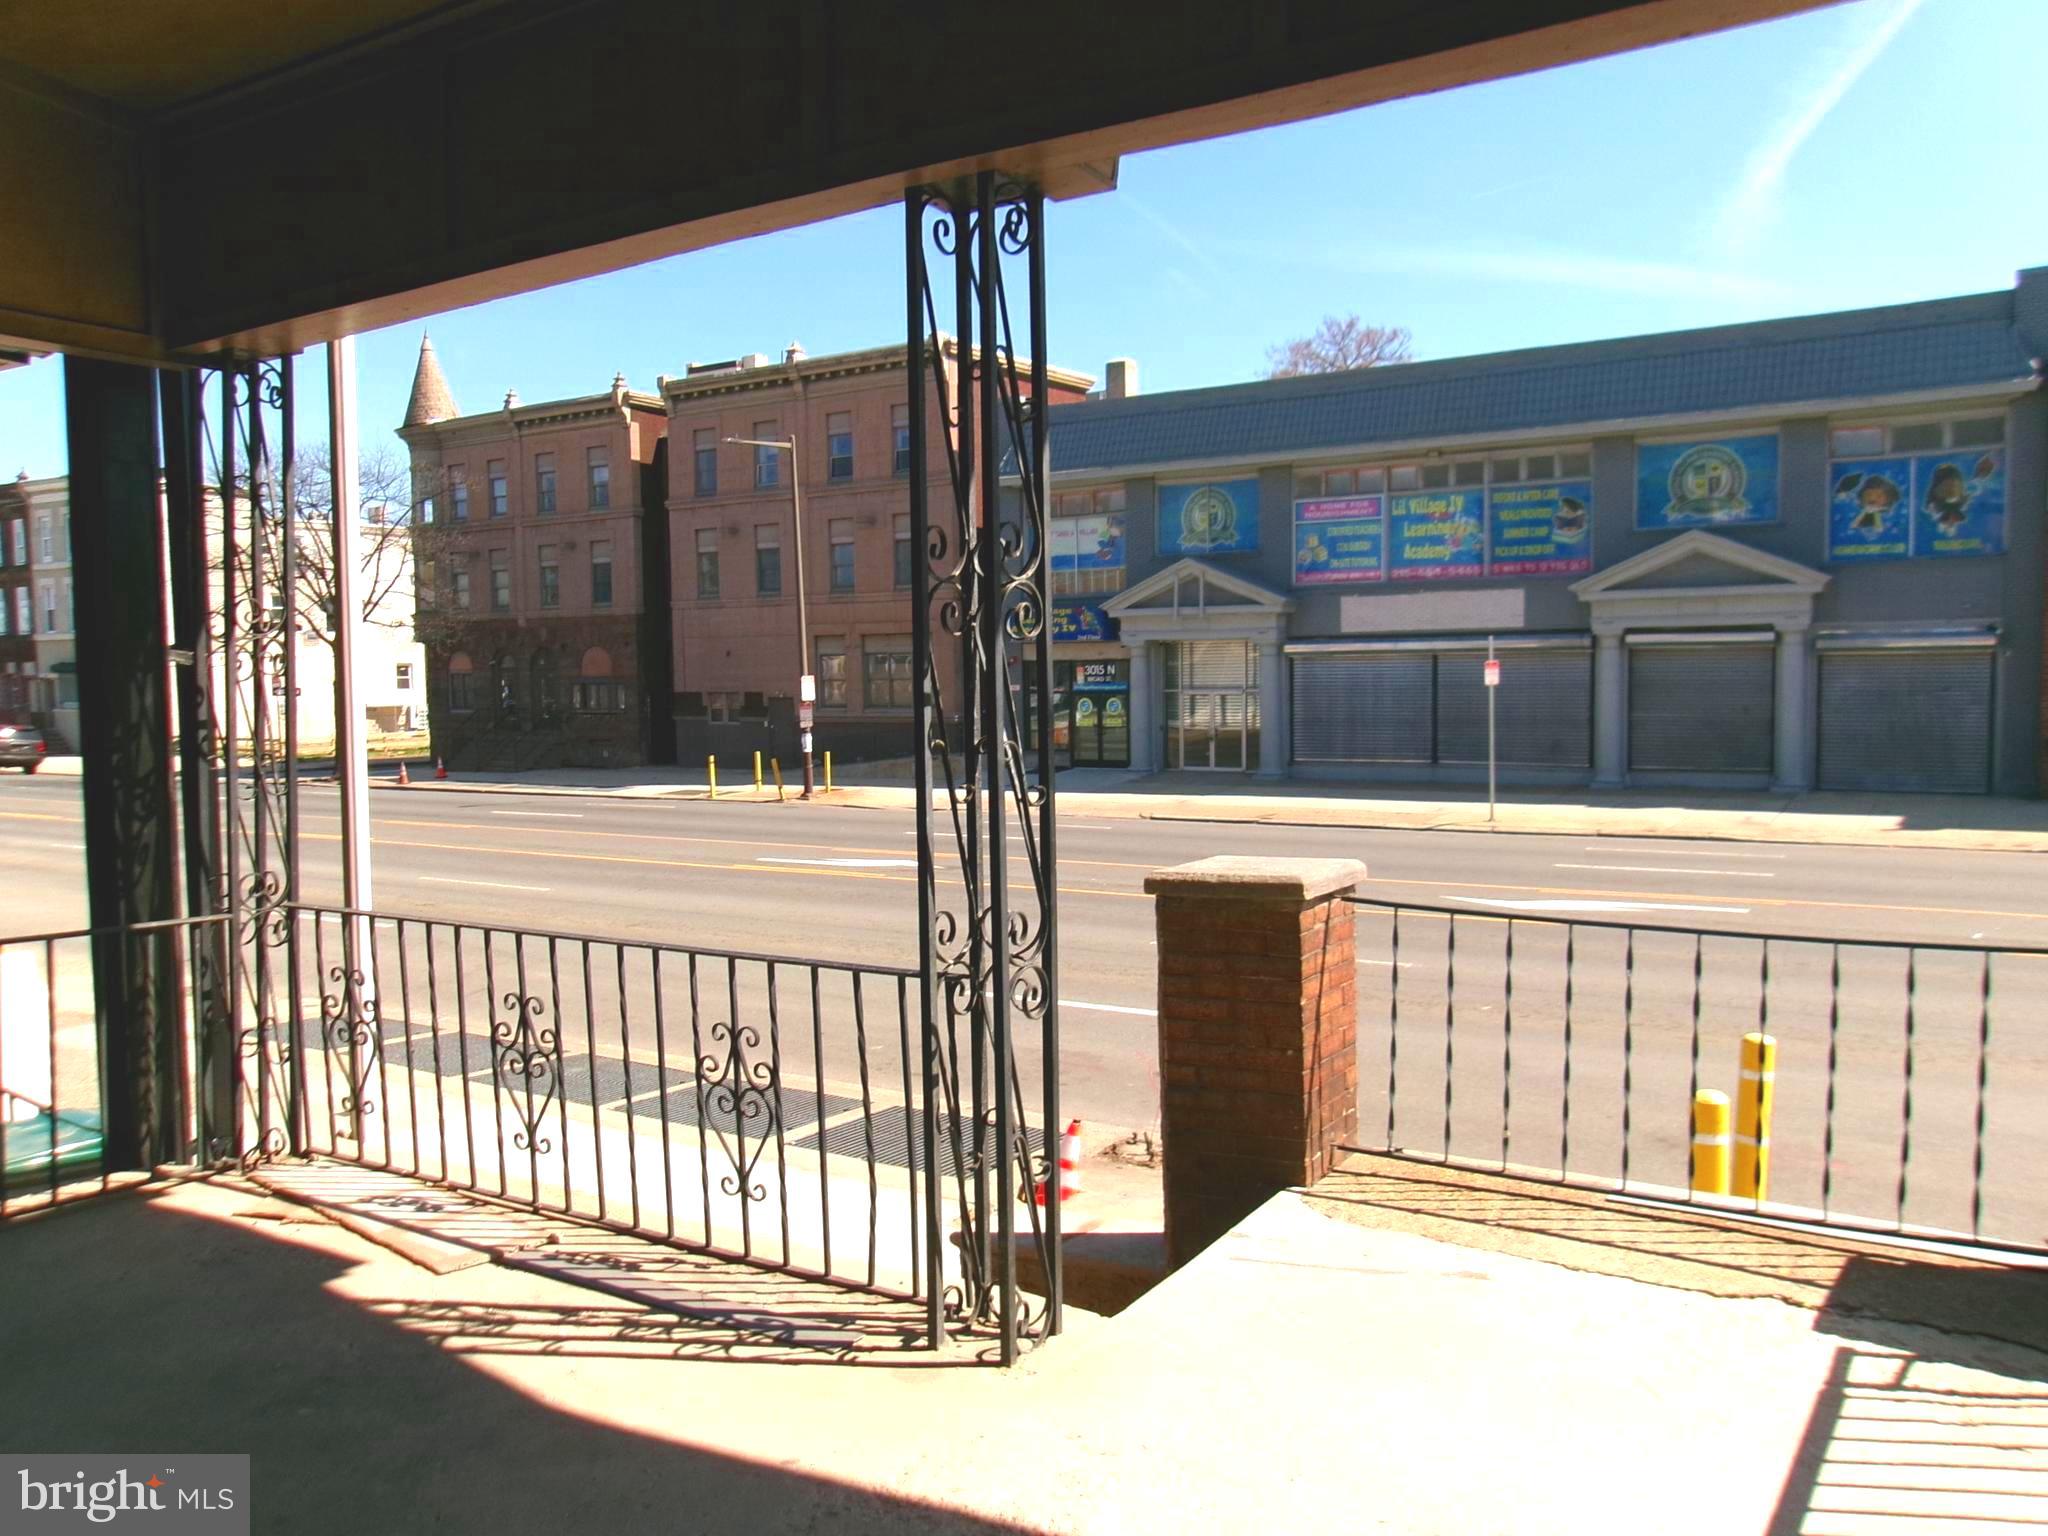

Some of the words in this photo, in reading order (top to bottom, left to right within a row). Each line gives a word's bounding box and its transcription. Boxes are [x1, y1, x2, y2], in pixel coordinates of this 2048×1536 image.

[1409, 497, 1447, 516] Village
[1403, 543, 1451, 560] Academy
[1084, 664, 1105, 675] 3015
[1107, 664, 1115, 675] N
